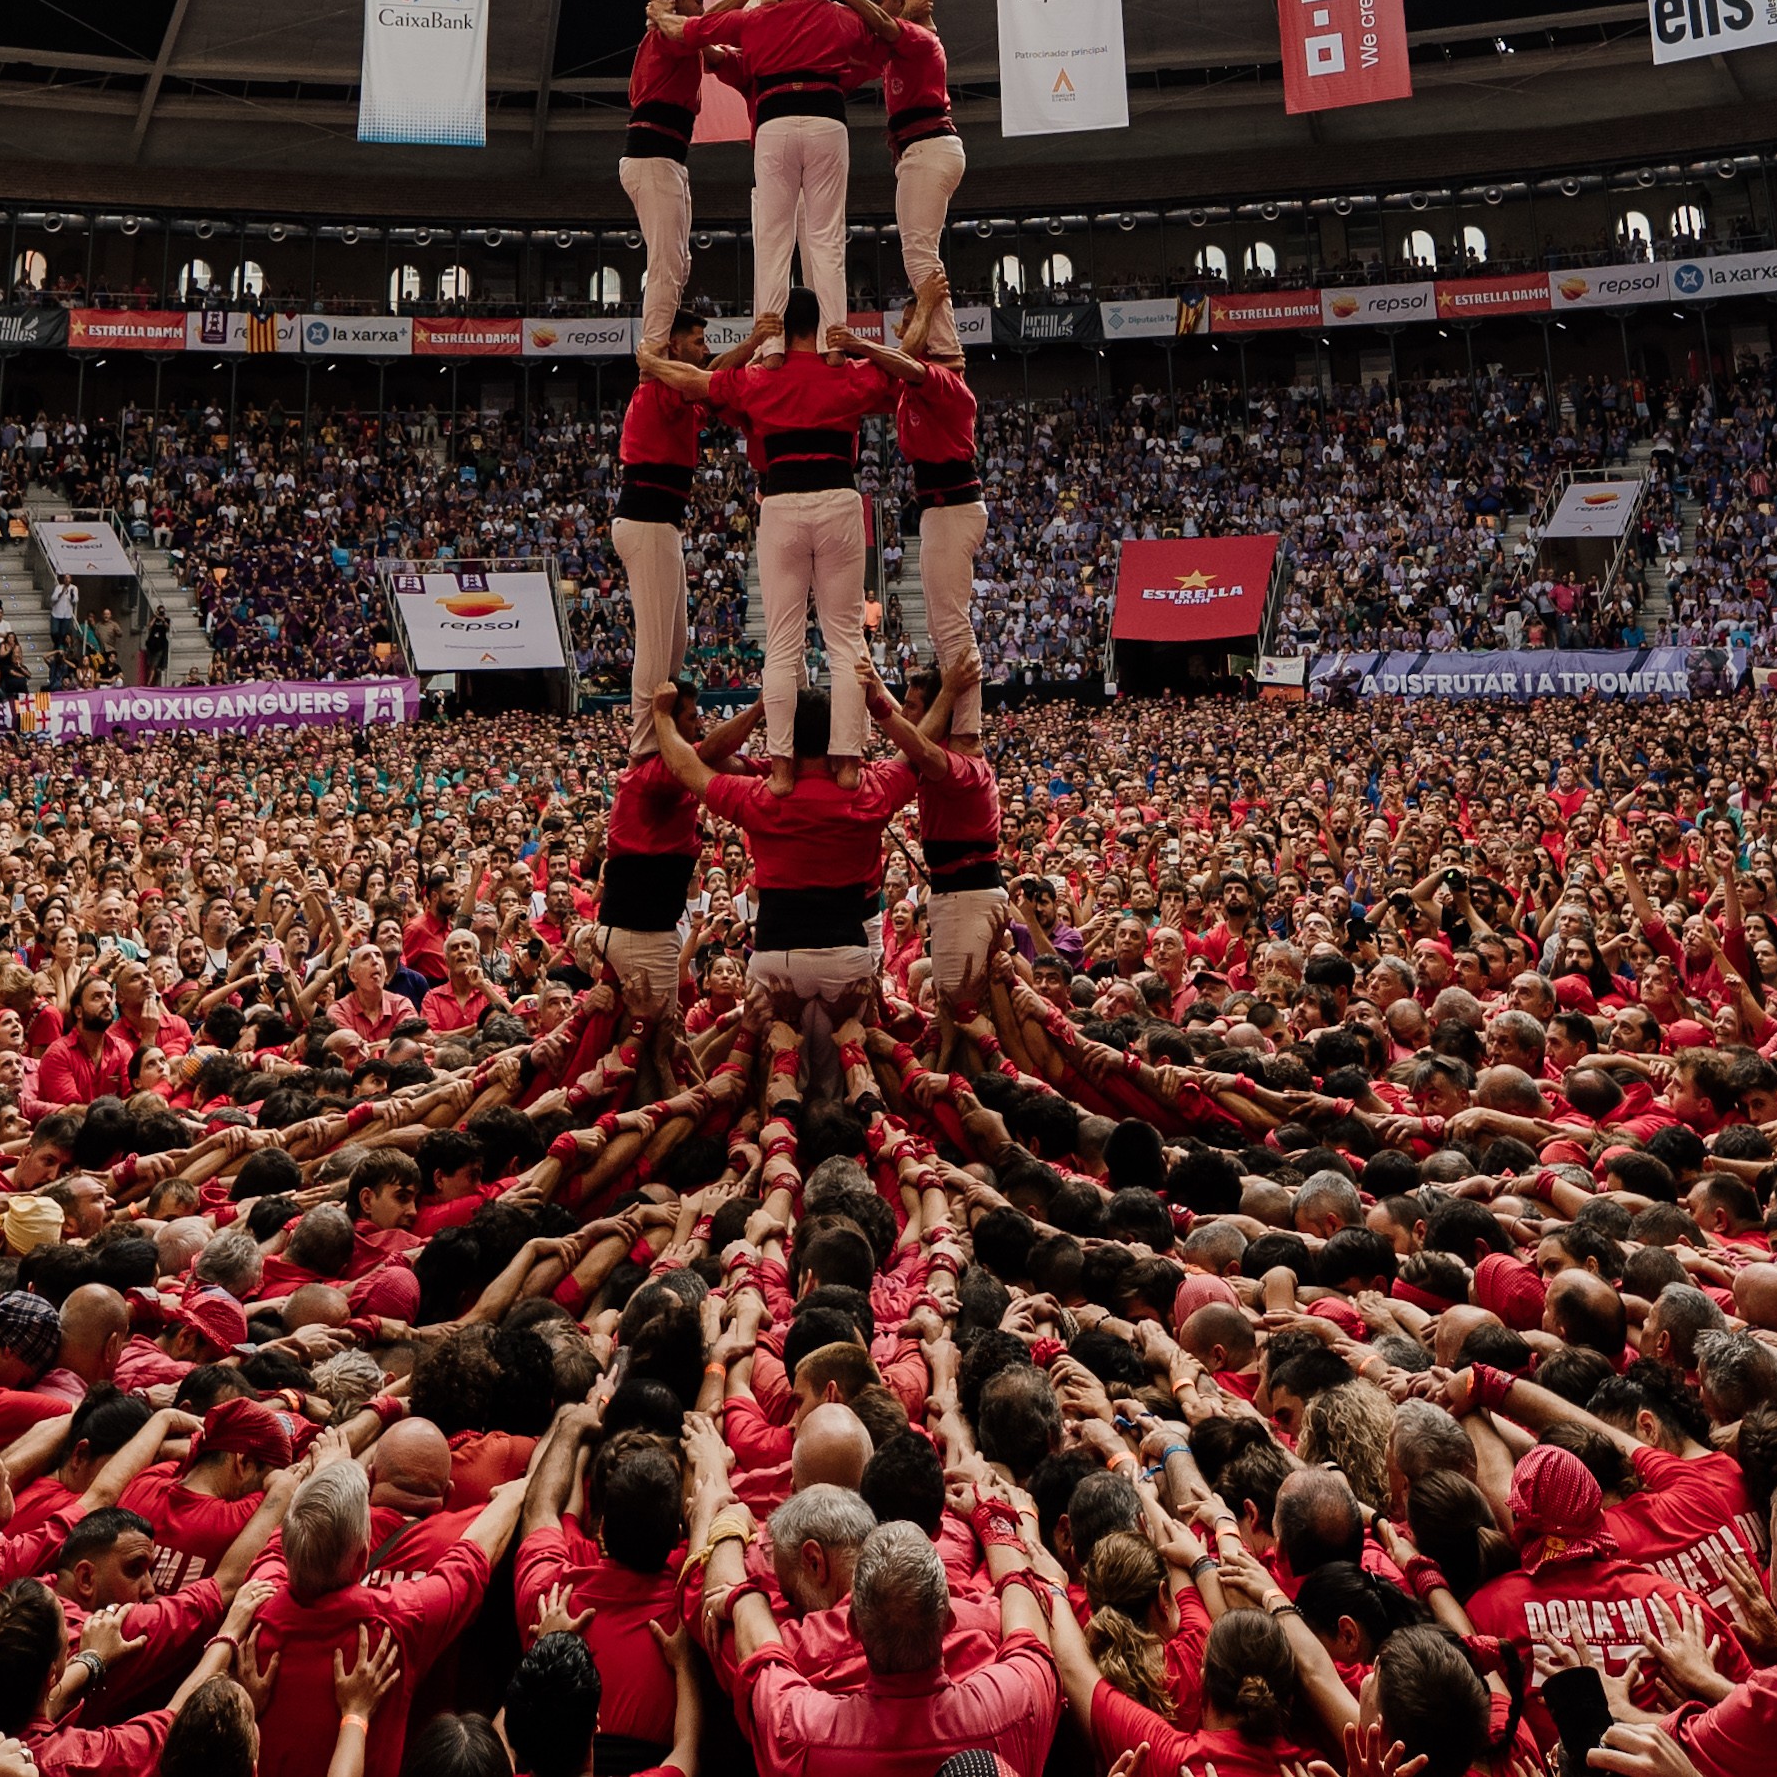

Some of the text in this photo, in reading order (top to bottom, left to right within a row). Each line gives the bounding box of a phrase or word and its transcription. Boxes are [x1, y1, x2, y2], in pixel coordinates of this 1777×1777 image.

[378, 8, 474, 30] CaixaBank
[1014, 45, 1108, 60] Patrocinador principal
[1360, 31, 1380, 69] We
[1597, 273, 1661, 295] repsol
[1710, 267, 1727, 285] la
[1368, 291, 1427, 314] repsol
[1455, 286, 1549, 306] ESTRELLA DAMM
[1128, 313, 1164, 325] Diputació
[1229, 303, 1320, 322] ESTRELLA DAMM
[88, 324, 184, 338] ESTRELLA DAMM
[332, 327, 348, 342] la
[430, 332, 520, 344] ESTRELLA DAMM
[567, 328, 624, 345] repsol
[1575, 503, 1619, 512] repsol
[1142, 585, 1243, 600] ESTRELLA
[440, 620, 520, 631] repsol
[1361, 674, 1380, 695] A
[1382, 673, 1518, 696] DISFRUTAR
[1524, 673, 1533, 694] I
[1539, 673, 1558, 694] A
[104, 692, 350, 723] MOIXIGANGUERS
[1523, 1598, 1651, 1640] DONA'M
